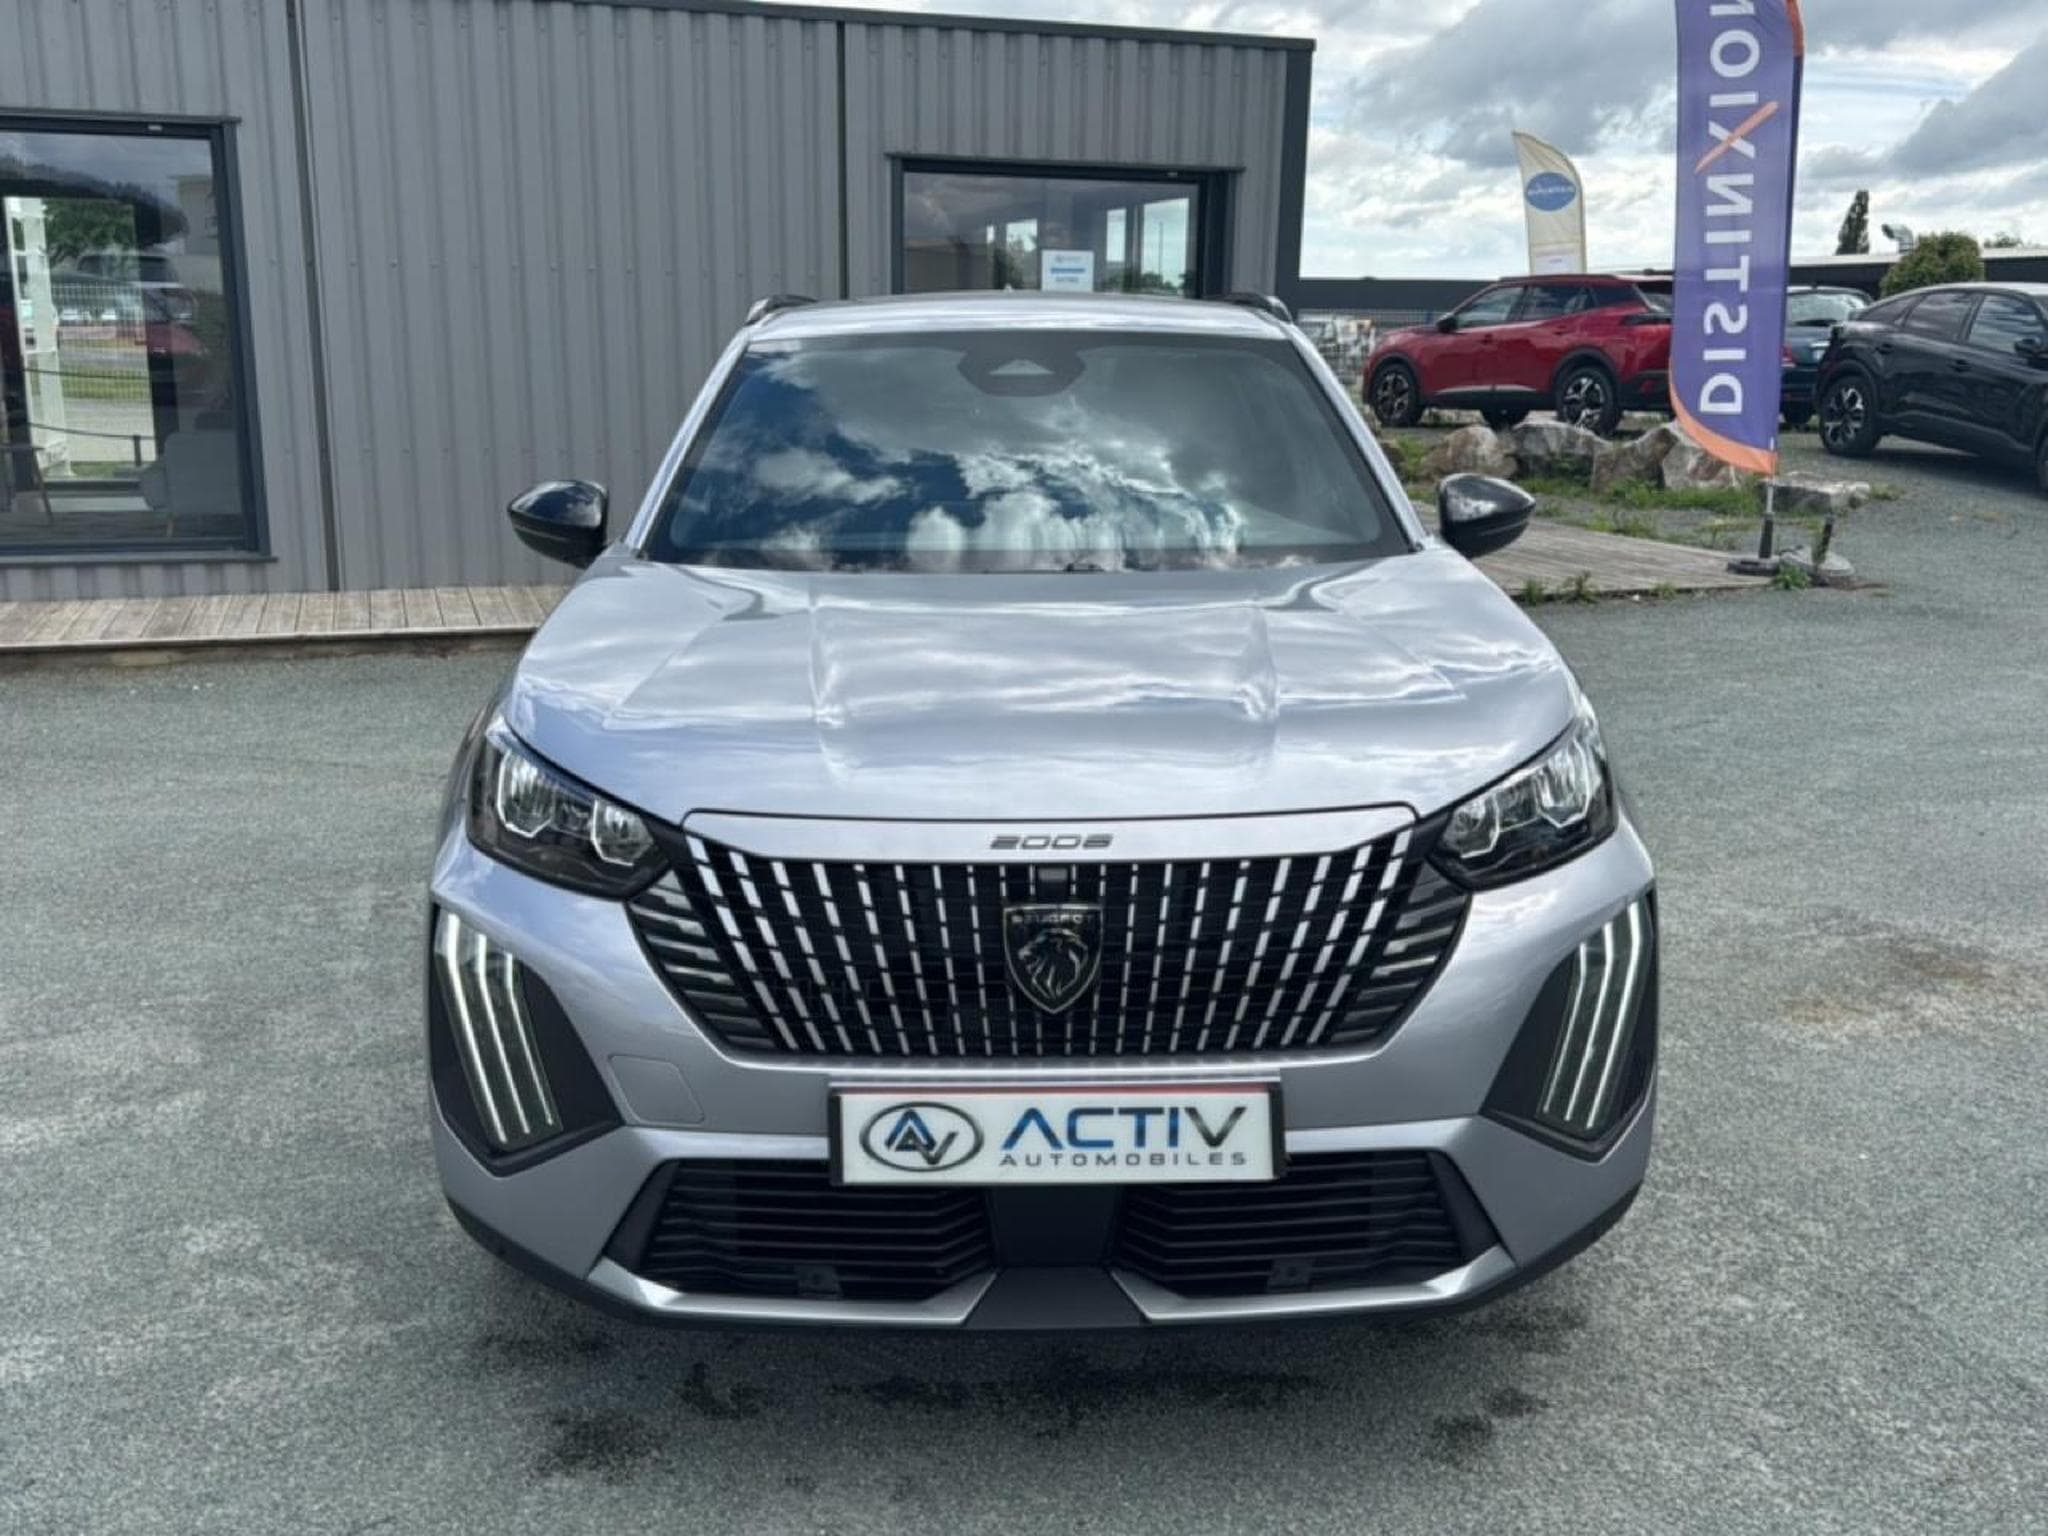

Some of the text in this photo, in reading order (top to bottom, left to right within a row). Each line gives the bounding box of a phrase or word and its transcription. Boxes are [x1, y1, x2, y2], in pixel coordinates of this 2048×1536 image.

[990, 835, 1114, 850] 2008
[1003, 1106, 1248, 1150] ACTIV
[999, 1152, 1247, 1167] AUTOMOBILES
